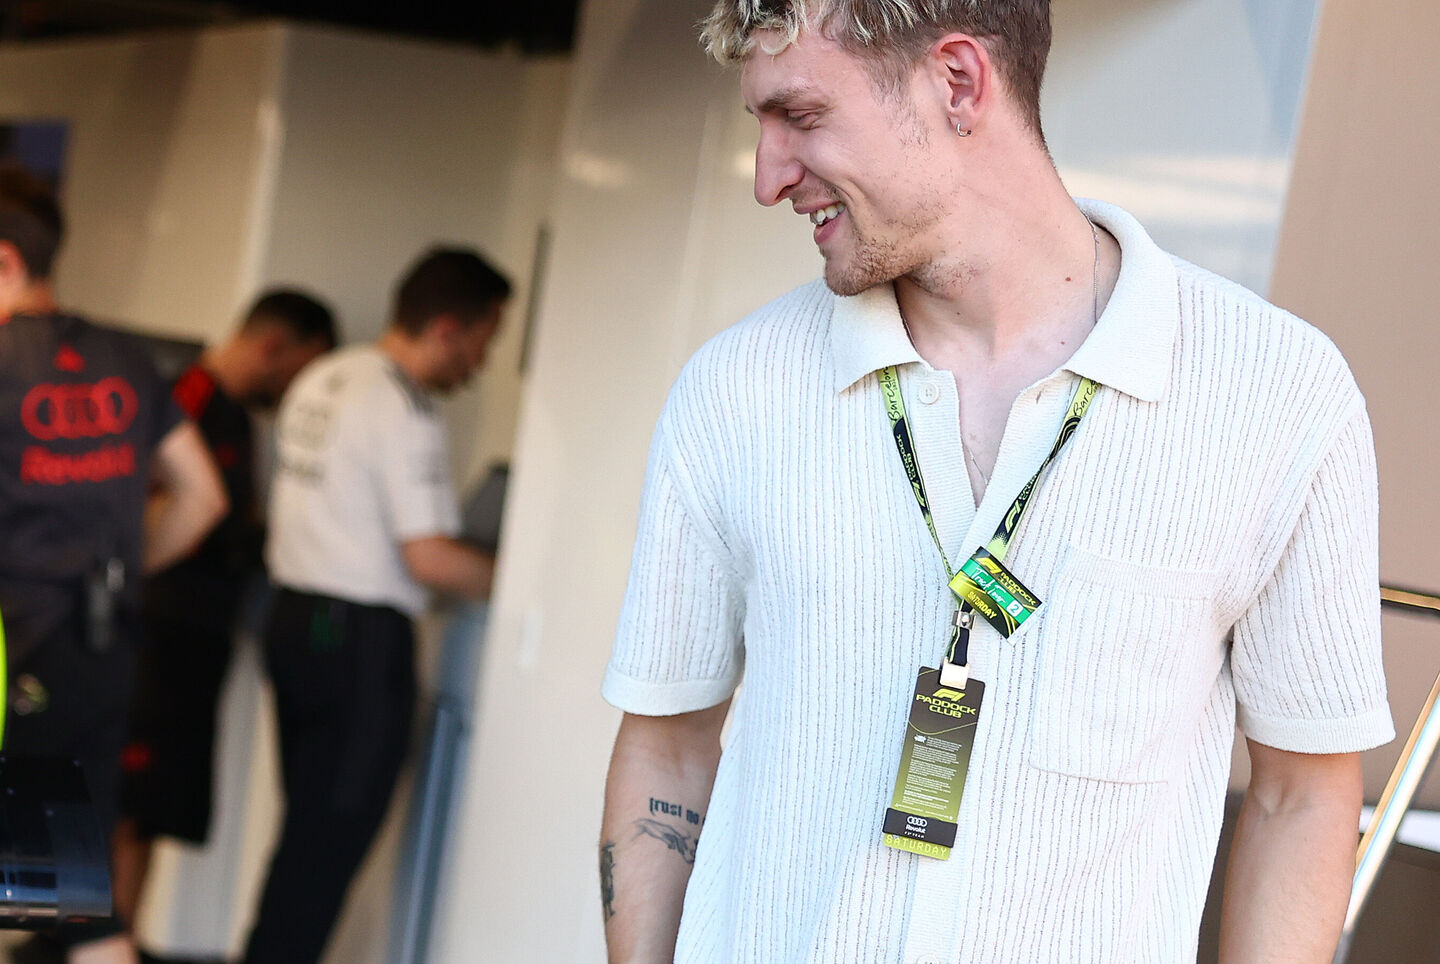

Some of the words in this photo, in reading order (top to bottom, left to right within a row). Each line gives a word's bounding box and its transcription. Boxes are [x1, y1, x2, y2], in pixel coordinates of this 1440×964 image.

[879, 367, 902, 422] Barcelon
[1000, 572, 1037, 606] PADDOCK
[967, 591, 998, 619] SATURDAY
[1010, 604, 1020, 614] 2
[915, 694, 976, 715] PADDOCK
[928, 705, 962, 719] CLUB
[649, 797, 682, 818] trust
[885, 833, 948, 856] SATURDAY
